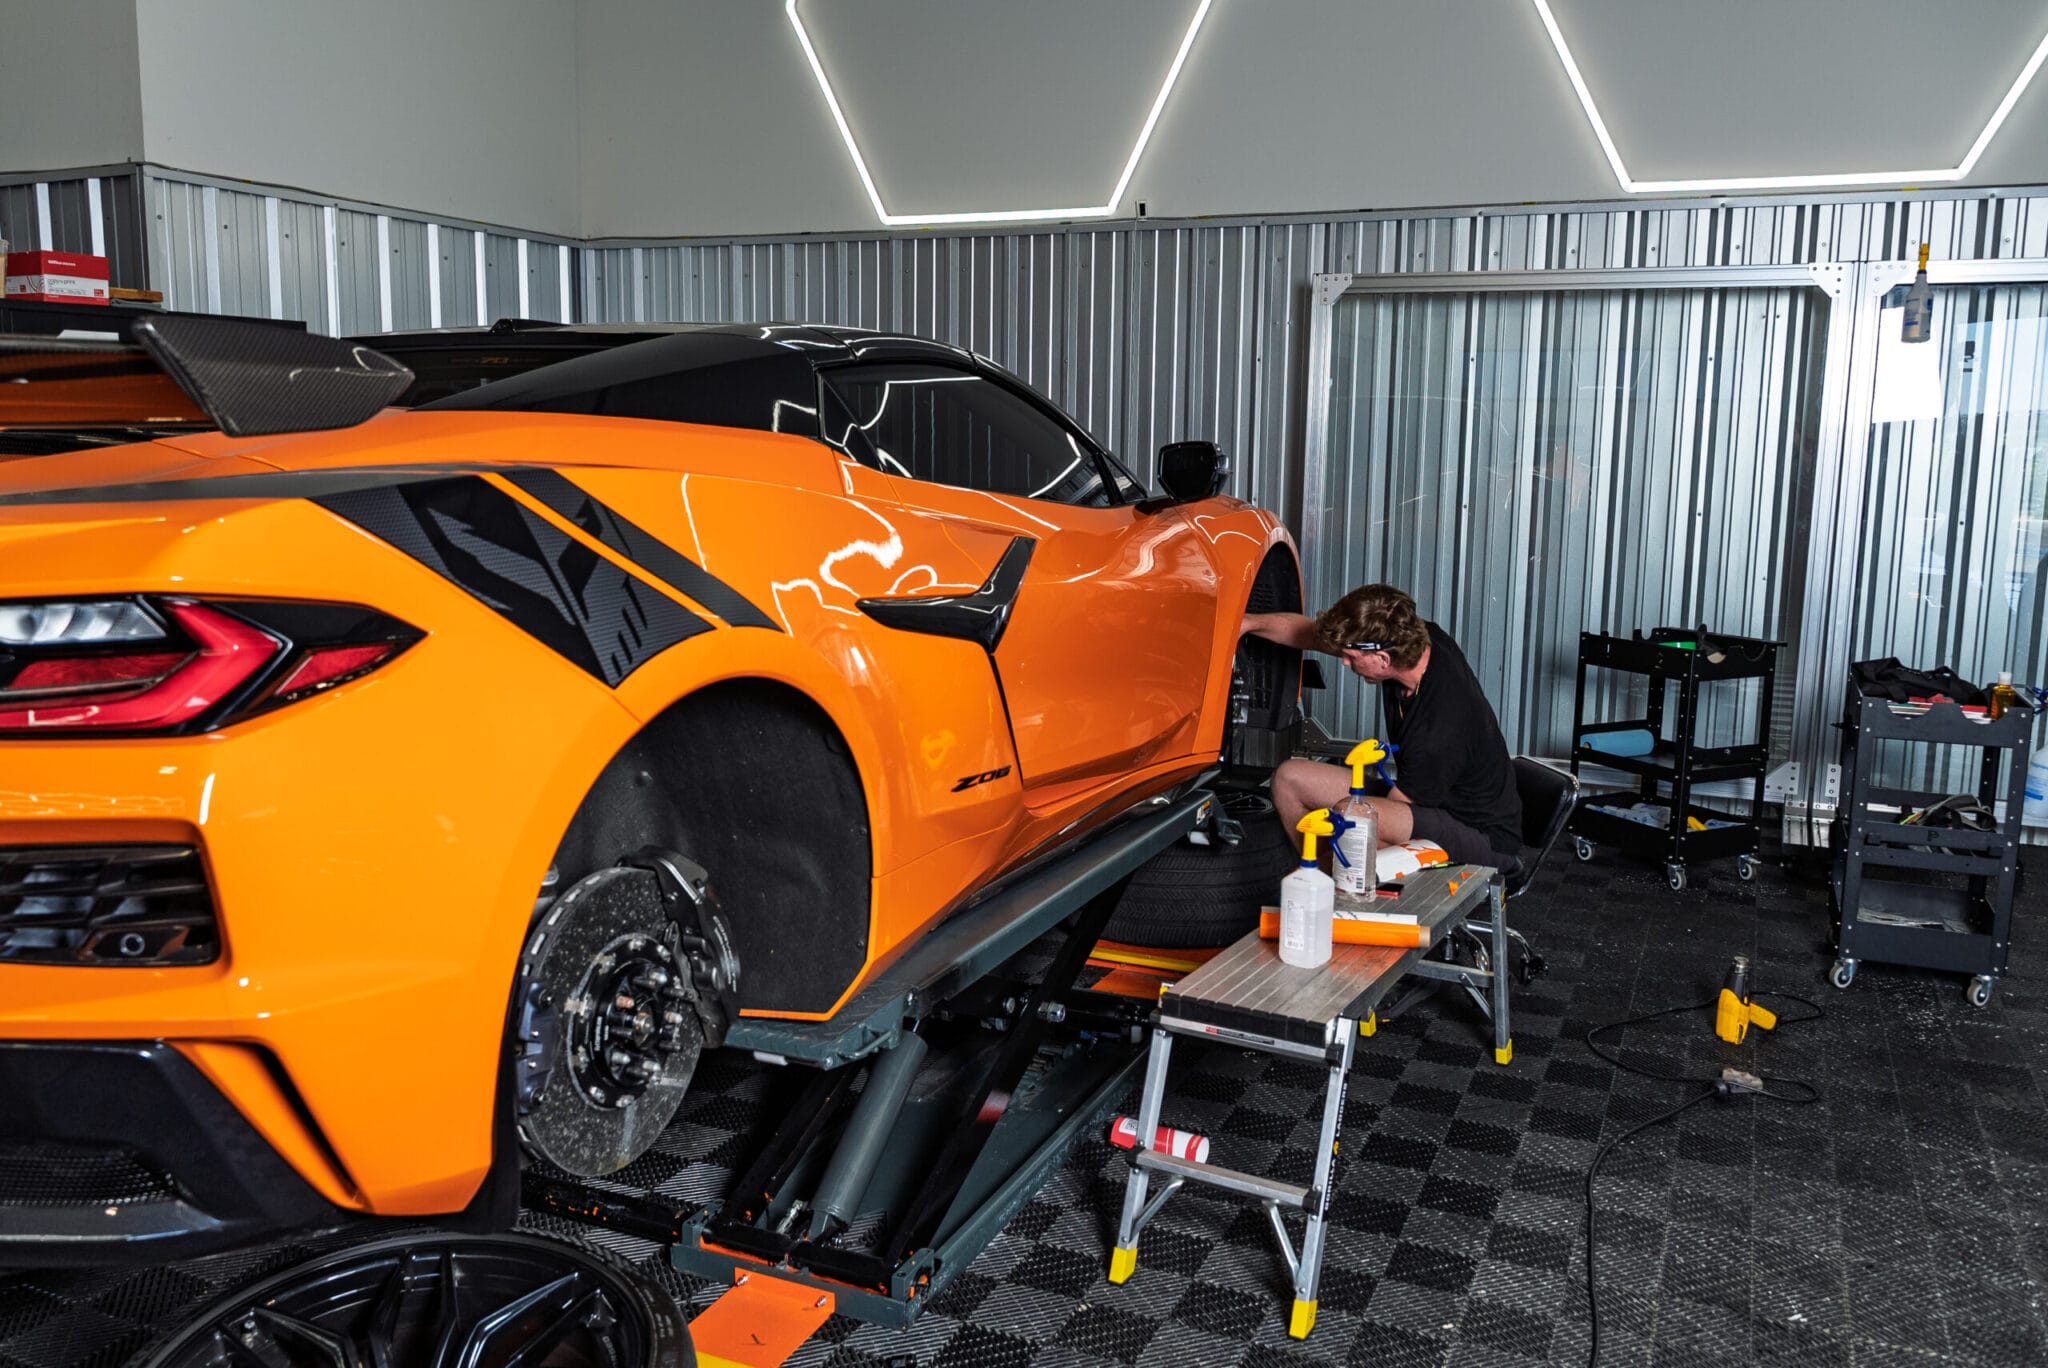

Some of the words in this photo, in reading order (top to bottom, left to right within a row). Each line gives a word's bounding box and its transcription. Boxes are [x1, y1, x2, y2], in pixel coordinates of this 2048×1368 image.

[950, 764, 1012, 793] Z06
[1324, 1158, 1336, 1212] GORILLA
[1335, 1082, 1348, 1138] LADDERS
